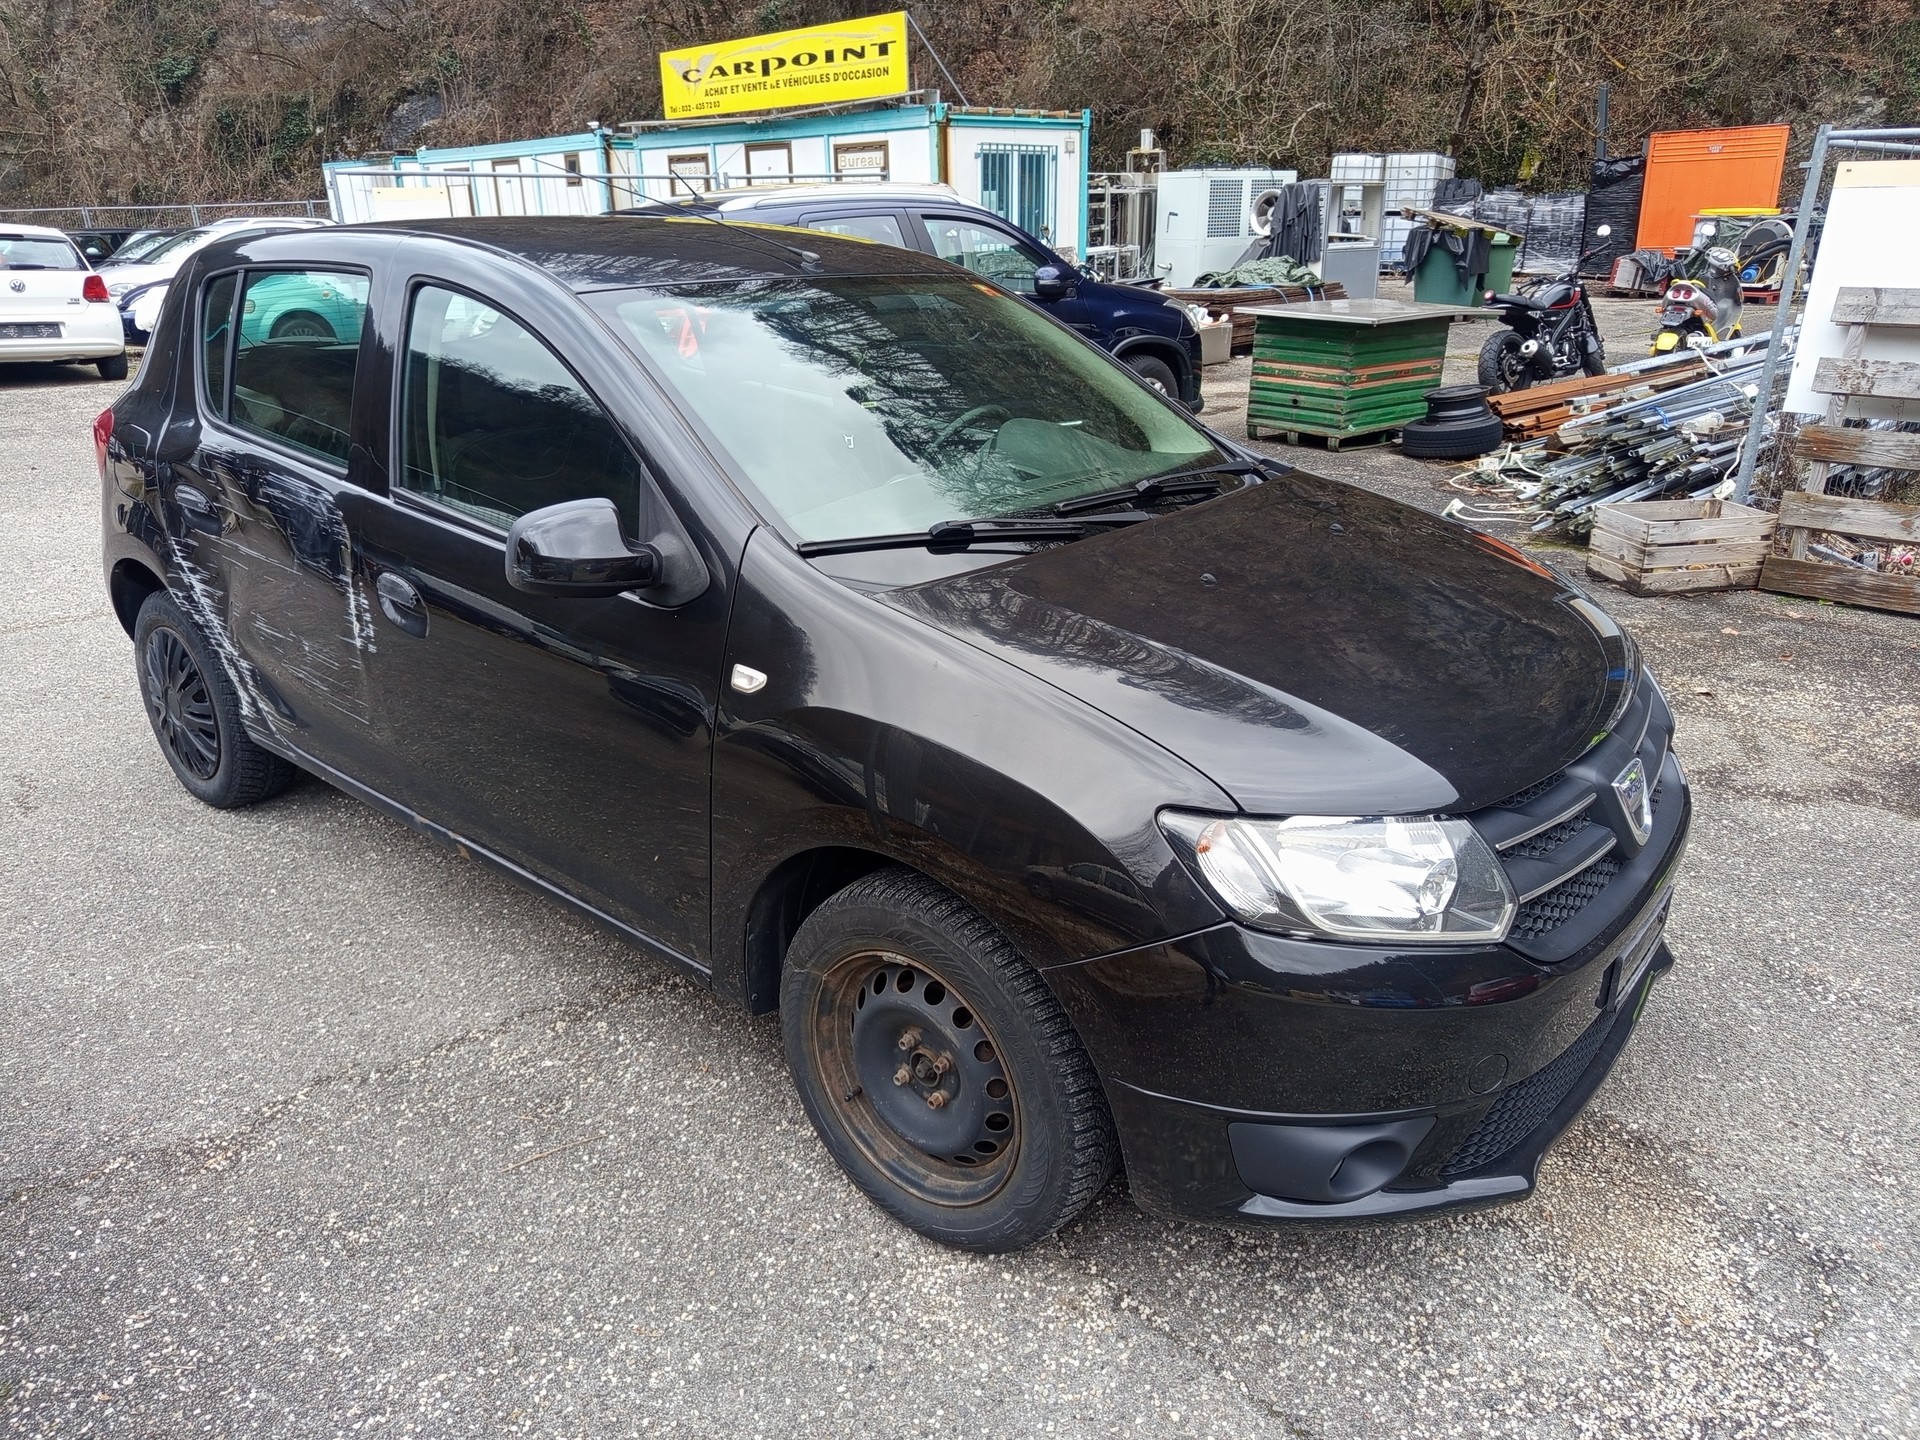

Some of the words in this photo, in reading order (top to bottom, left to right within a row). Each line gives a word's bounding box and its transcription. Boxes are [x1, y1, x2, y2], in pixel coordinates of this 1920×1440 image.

[682, 40, 897, 84] CARPOINT
[704, 86, 728, 97] ACHAT
[730, 84, 740, 94] ET
[741, 81, 768, 92] VENTE
[782, 73, 831, 88] VÉHICULES
[833, 66, 889, 82] D'OCCASION
[673, 164, 705, 175] Bureau
[840, 155, 882, 168] Bureau
